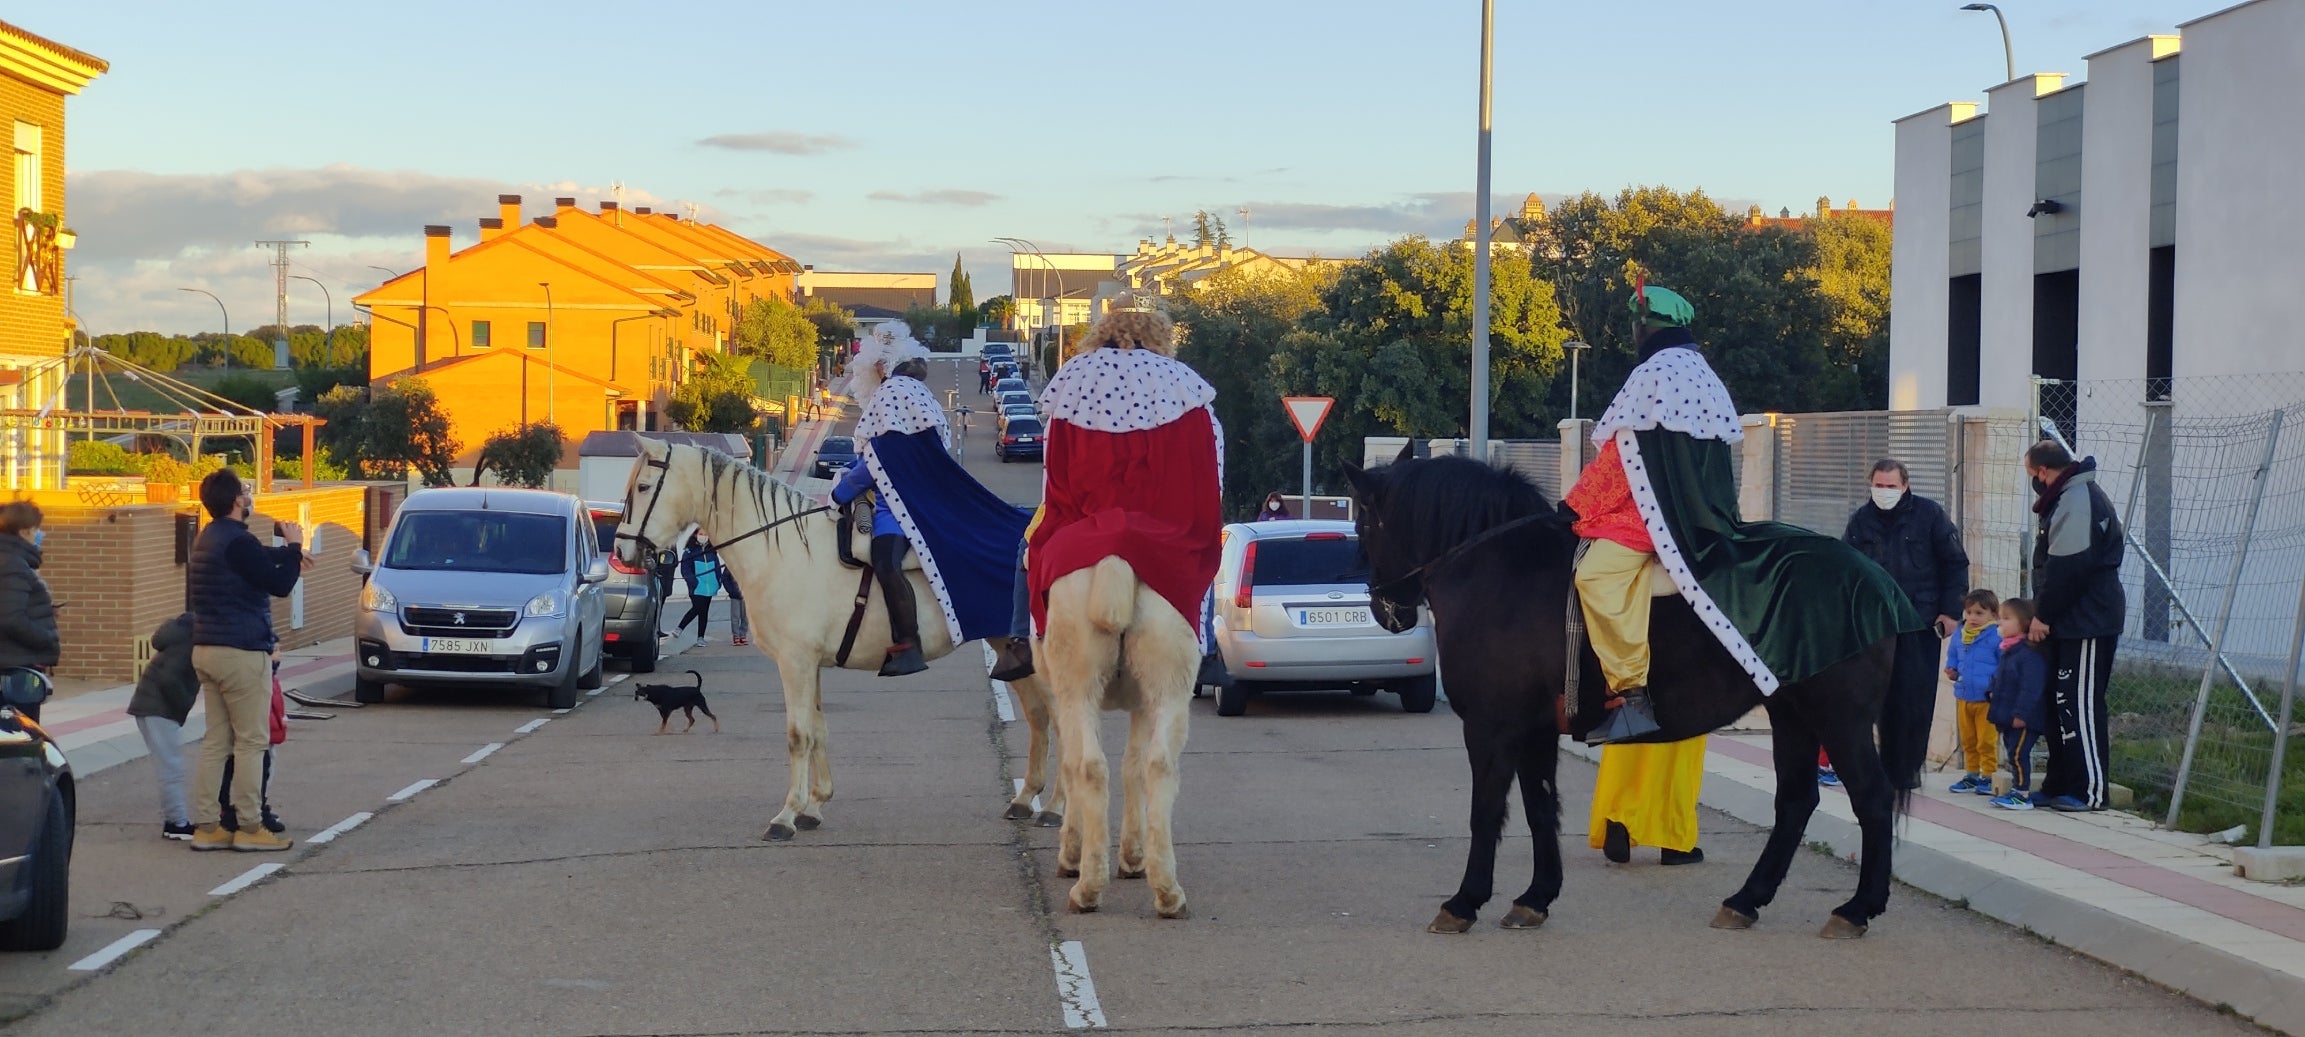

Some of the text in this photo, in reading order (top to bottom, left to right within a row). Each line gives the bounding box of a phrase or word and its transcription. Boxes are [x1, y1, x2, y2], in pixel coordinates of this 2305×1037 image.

[1309, 611, 1367, 623] 6501 CRB
[431, 639, 488, 653] 7585 JXN
